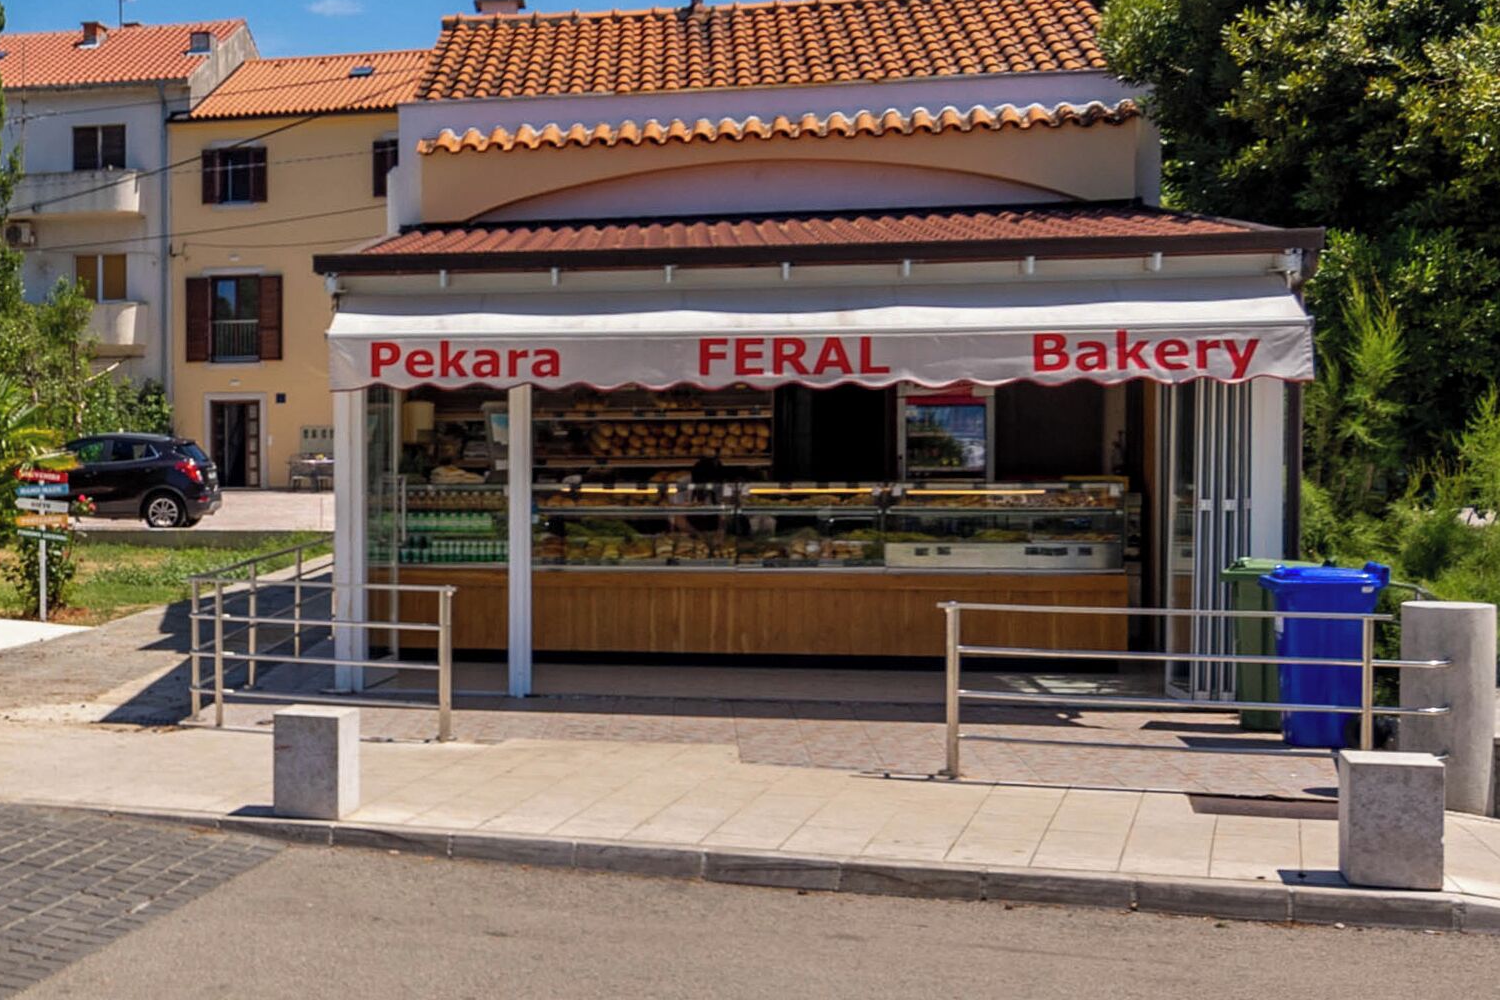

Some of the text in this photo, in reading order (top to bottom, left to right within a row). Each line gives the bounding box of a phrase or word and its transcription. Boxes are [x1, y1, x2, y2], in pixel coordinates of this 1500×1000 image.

[370, 328, 1260, 379] Pekara FERAL Bakery
